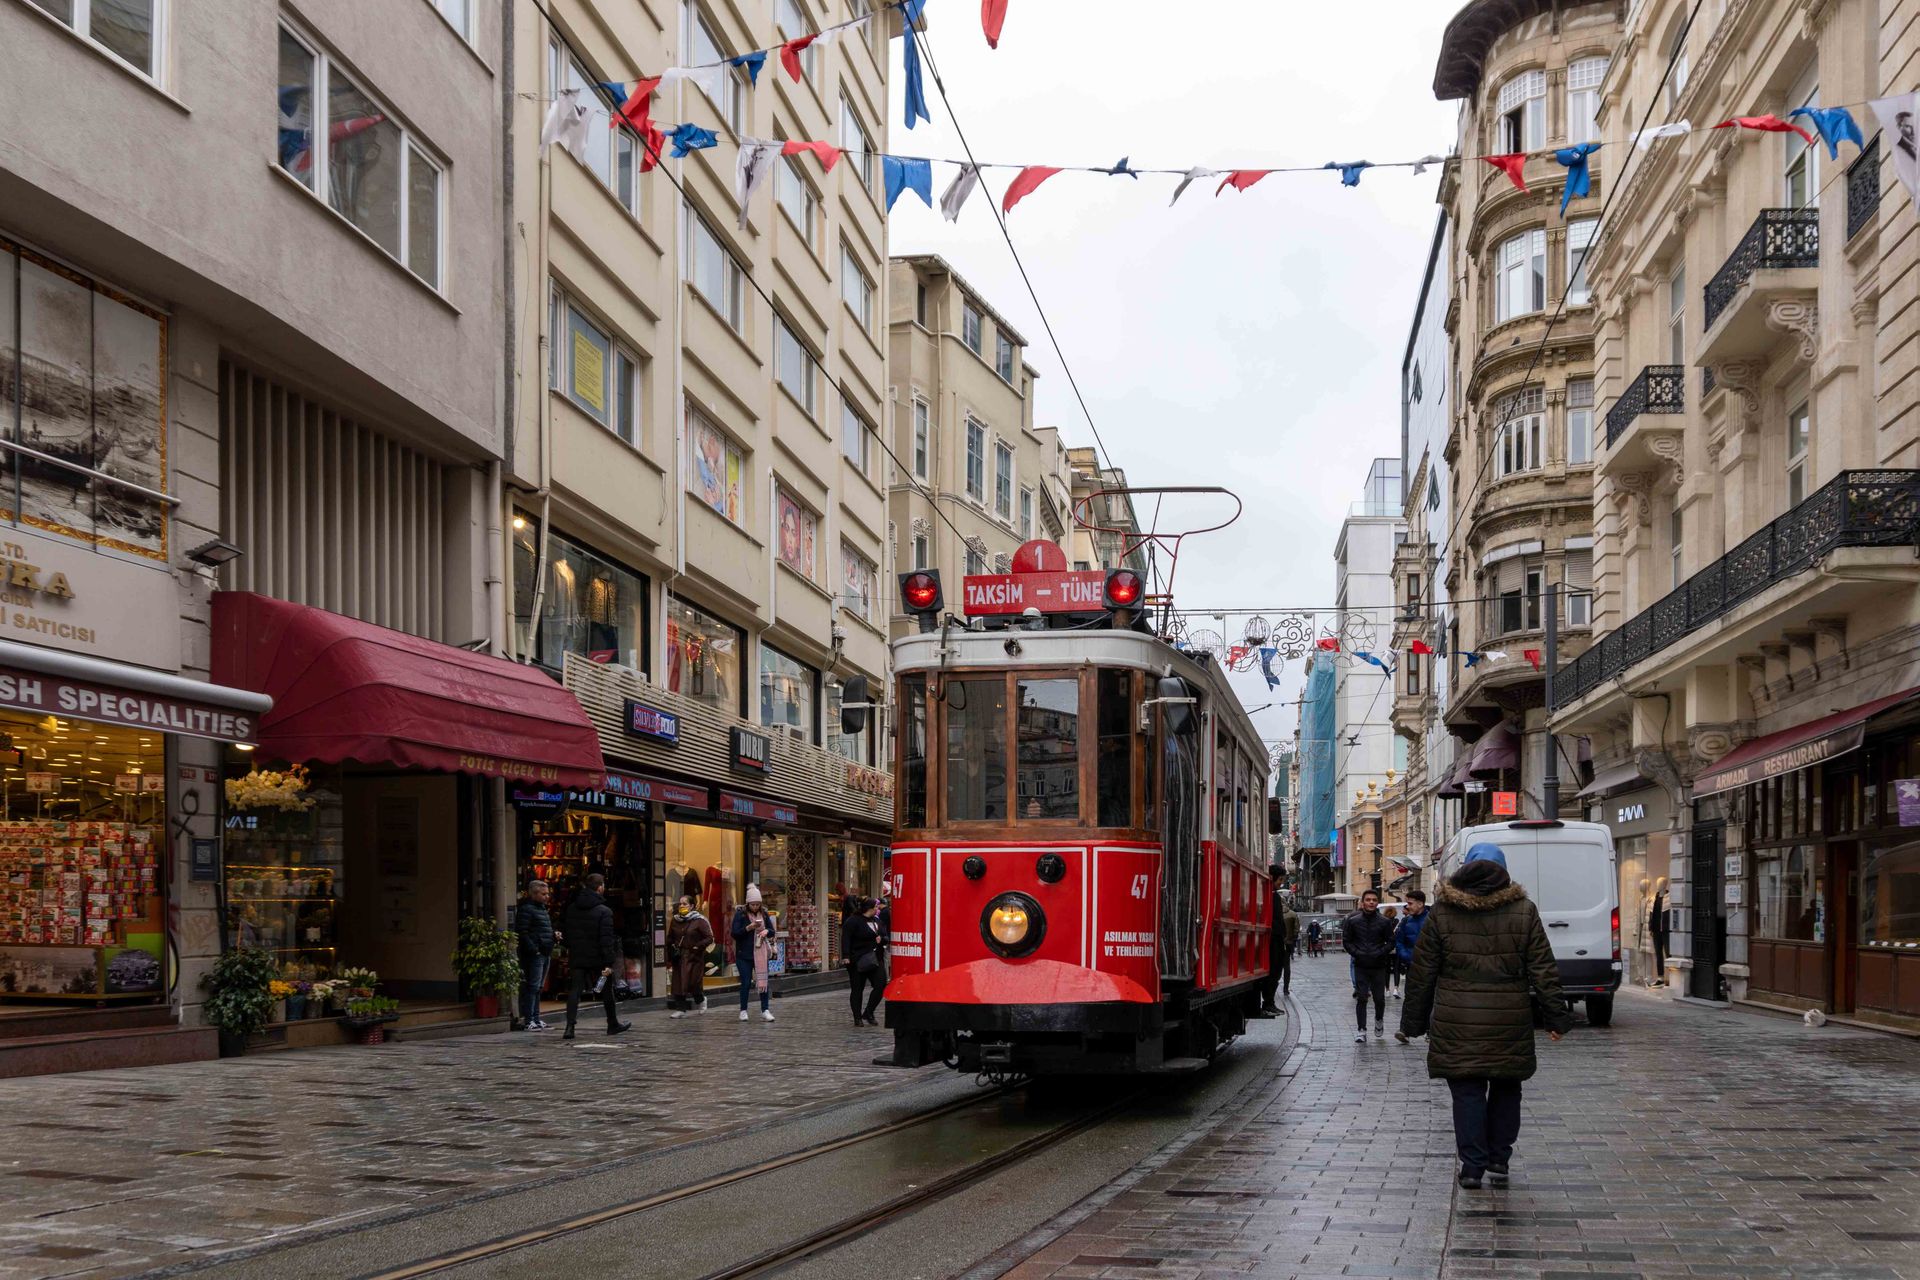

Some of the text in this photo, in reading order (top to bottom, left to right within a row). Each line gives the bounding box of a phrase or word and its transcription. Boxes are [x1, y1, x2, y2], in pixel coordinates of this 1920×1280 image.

[1034, 544, 1044, 571] 1
[967, 579, 1023, 606] TAKSİM
[13, 613, 96, 644] SATICISI
[57, 685, 251, 738] SPECIALITIES
[660, 716, 675, 736] POLO
[740, 732, 763, 761] DURU
[1715, 739, 1829, 790] ARMADA RESTAURANT
[631, 780, 651, 798] POLO
[615, 796, 627, 809] BAG
[627, 798, 646, 811] STORE
[892, 873, 904, 899] 47
[1131, 874, 1149, 899] 47
[902, 932, 923, 943] YASAK
[1104, 931, 1137, 943] ASILMAK
[1104, 945, 1114, 957] VE
